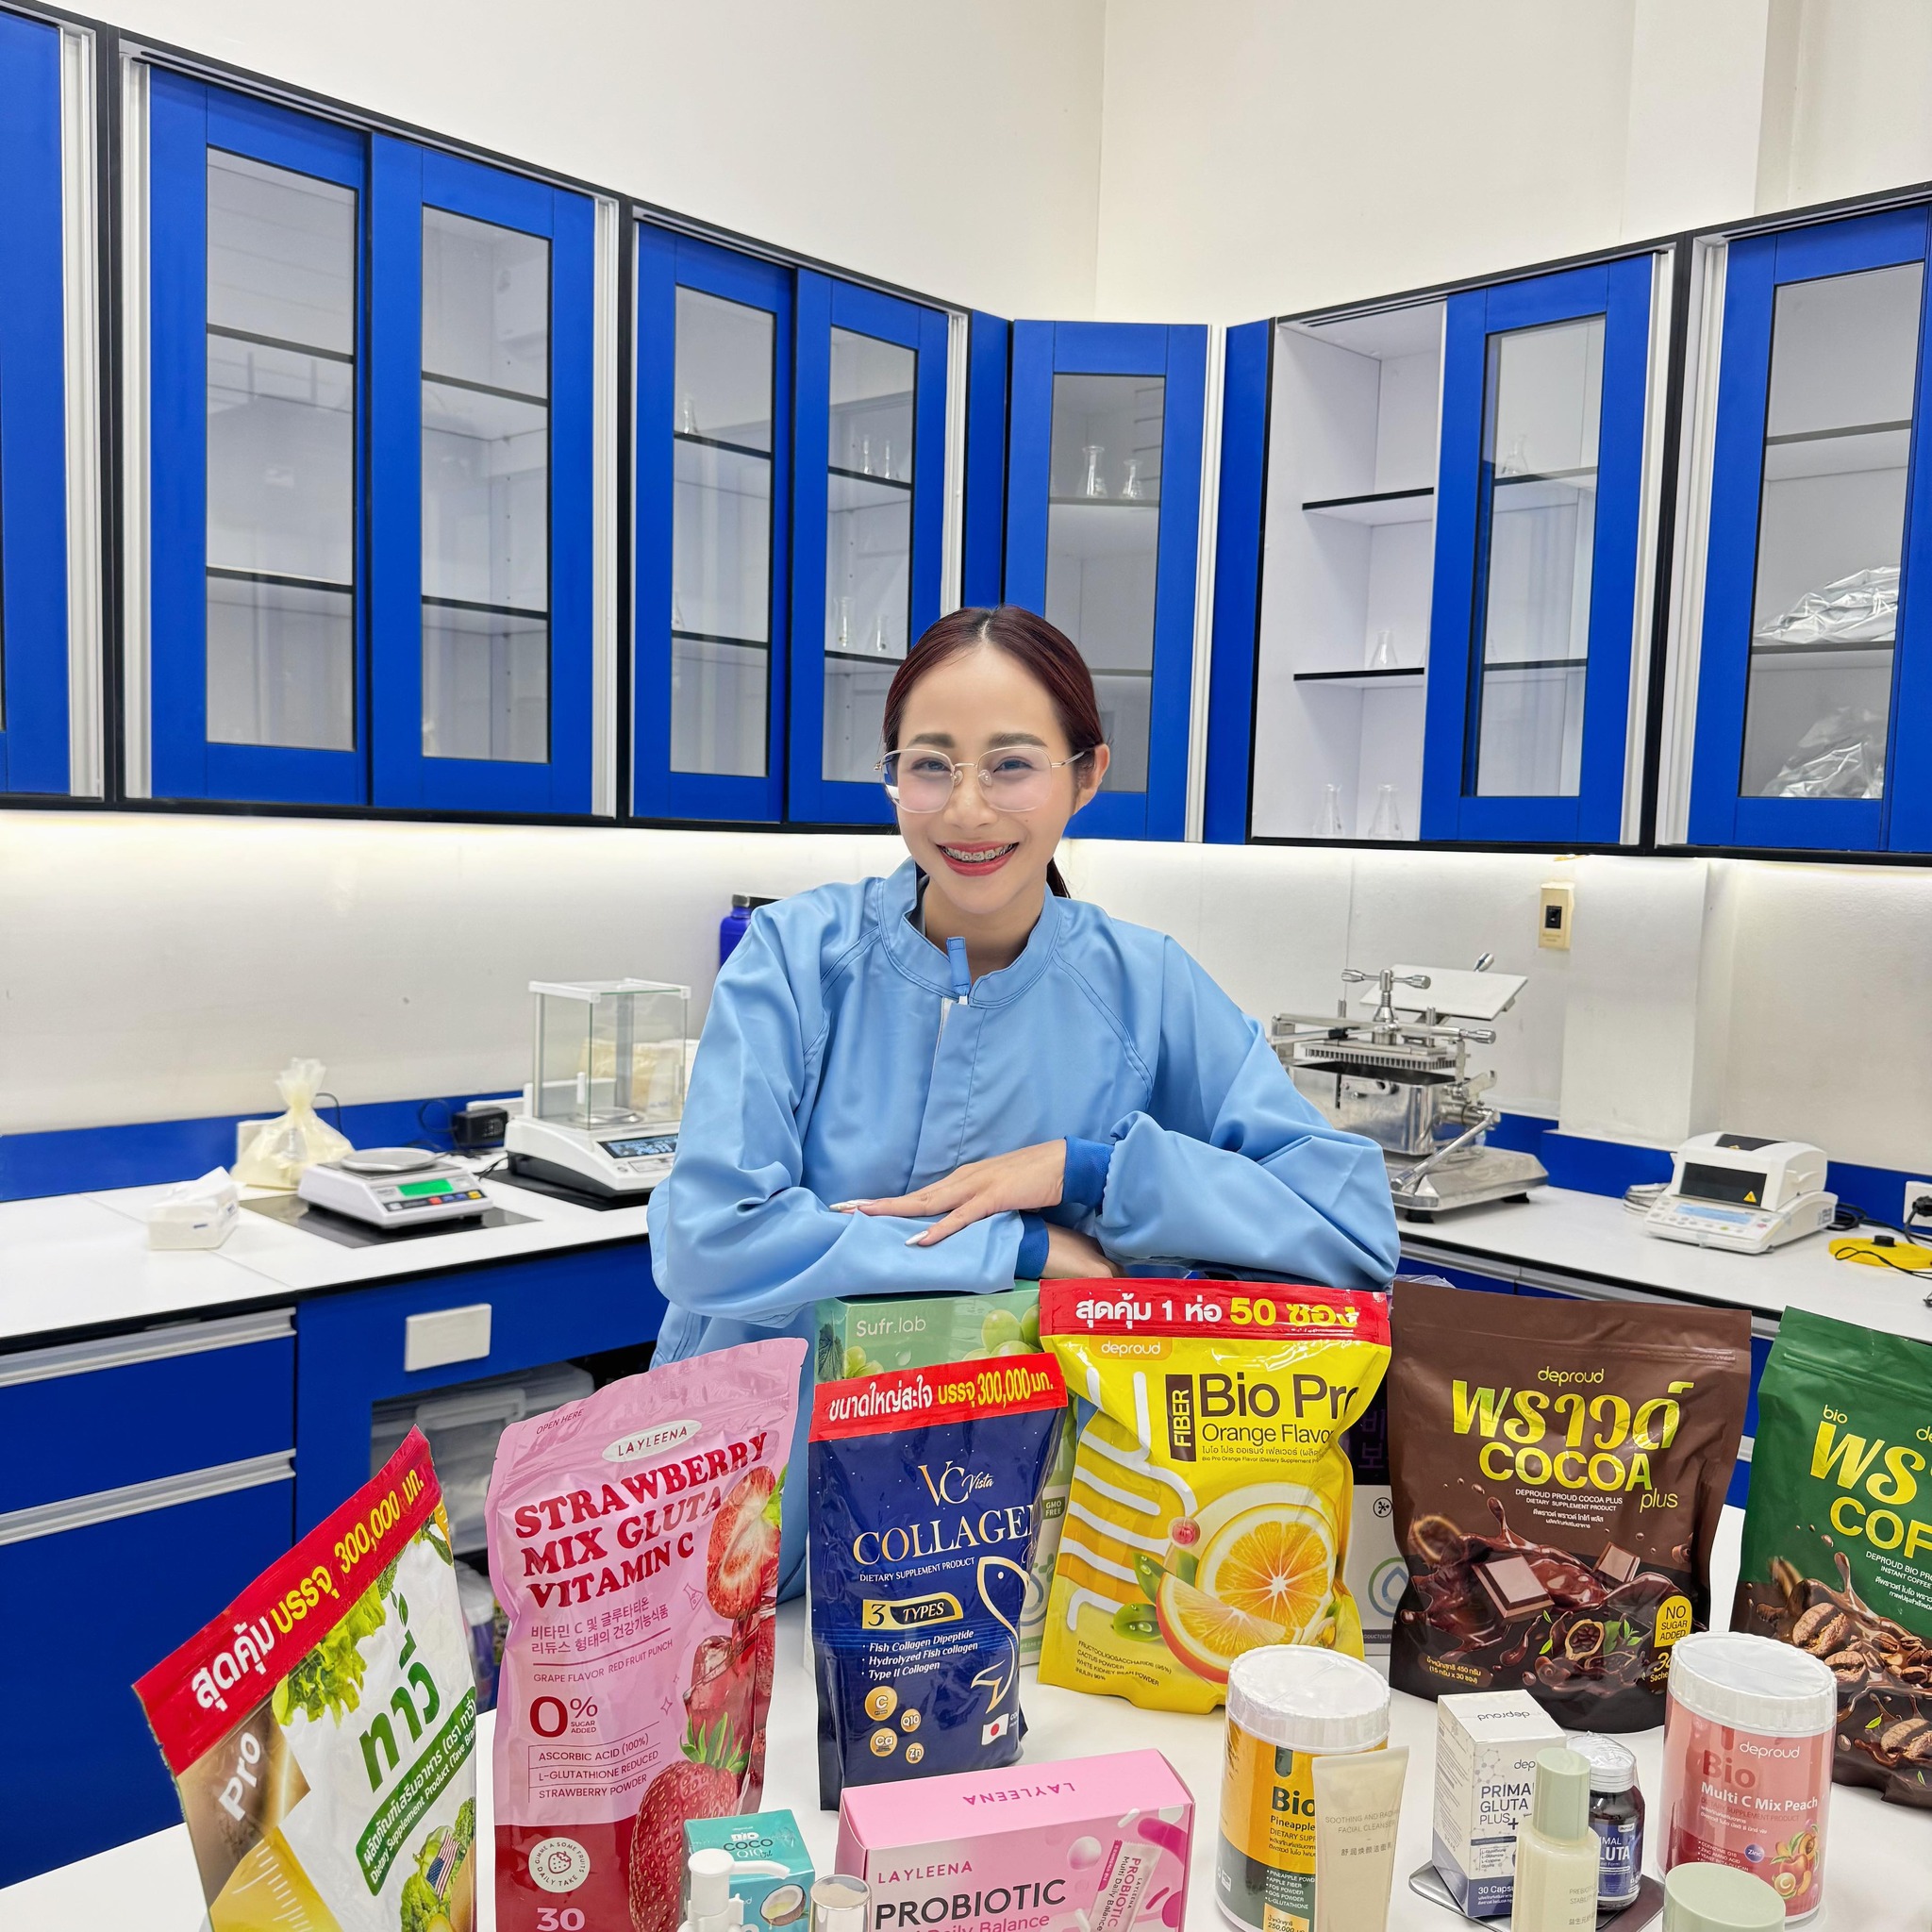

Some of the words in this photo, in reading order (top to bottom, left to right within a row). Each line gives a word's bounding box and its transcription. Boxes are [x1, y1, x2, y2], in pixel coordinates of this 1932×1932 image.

[1075, 1292, 1152, 1329] สุดคุ้ม
[1161, 1300, 1173, 1322] 1
[1185, 1295, 1222, 1322] ห่อ
[1230, 1298, 1276, 1326] 50
[856, 1315, 926, 1338] Sufr.lab
[1101, 1341, 1161, 1359] deproud
[1538, 1365, 1605, 1387] deproud
[829, 1374, 933, 1422] ขนาดใหญ่สะใจ
[938, 1379, 975, 1408] บรรจุ
[976, 1367, 1031, 1408] 300,000
[1031, 1371, 1055, 1393] มก.
[1199, 1372, 1280, 1418] Bio
[536, 1419, 559, 1436] OPEN
[561, 1408, 585, 1426] HERE
[1172, 1388, 1191, 1448] FIBER
[1452, 1379, 1695, 1451] พราวด์
[1823, 1404, 1848, 1424] bio
[618, 1426, 689, 1457] LAYLEENA
[1202, 1423, 1276, 1446] Orange
[1281, 1424, 1334, 1443] Flavo
[1478, 1441, 1653, 1492] COCOA
[514, 1432, 769, 1539] STRAWBERRY
[962, 1471, 994, 1494] Vista
[1045, 1500, 1062, 1509] GMO
[1515, 1489, 1551, 1499] DEPROUD
[1552, 1492, 1577, 1502] PROUD
[1579, 1494, 1605, 1504] COCOA
[1552, 1500, 1590, 1509] SUPPLEMENT
[1640, 1488, 1678, 1513] plus
[1045, 1507, 1062, 1517] FREE
[522, 1526, 608, 1577] MIX
[616, 1486, 723, 1550] GLUTA
[1830, 1496, 1932, 1559] COF
[526, 1541, 671, 1609] VITAMIN
[676, 1532, 695, 1558] C
[859, 1573, 894, 1582] DIETARY
[896, 1564, 941, 1580] SUPPLEMENT
[942, 1557, 975, 1570] PRODUCT
[1865, 1551, 1904, 1570] DEPROUD
[1905, 1565, 1919, 1575] BIO
[1880, 1565, 1907, 1579] INSTANT
[1907, 1575, 1932, 1590] COFFEE
[192, 1617, 275, 1712] สุดคุ้ม
[270, 1565, 341, 1634] บรรจุ
[334, 1491, 401, 1574] 300,000
[402, 1469, 425, 1506] มก.
[531, 1624, 570, 1641] 비타민
[575, 1623, 583, 1634] C
[587, 1617, 598, 1633] 및
[600, 1596, 650, 1628] 글루타티온
[868, 1604, 886, 1627] 3
[903, 1602, 944, 1622] TYPES
[1661, 1620, 1689, 1630] SUGAR
[1666, 1605, 1687, 1621] NO
[531, 1641, 572, 1655] 리듀스
[575, 1629, 610, 1652] 형태의
[613, 1604, 669, 1641] 건강기능식품
[869, 1642, 890, 1653] Fish
[891, 1639, 931, 1653] Collagen
[933, 1629, 974, 1645] Dipeptide
[1659, 1629, 1687, 1641] ADDED
[533, 1674, 566, 1683] GRAPE
[568, 1668, 605, 1683] FLAVOR
[608, 1661, 625, 1674] RED
[625, 1651, 647, 1667] FRUIT
[648, 1639, 674, 1658] PUNCH
[868, 1651, 921, 1668] Hydrolyzed
[923, 1648, 941, 1659] Fish
[942, 1642, 978, 1657] collagen
[1076, 1649, 1098, 1663] CACTUS
[1098, 1658, 1124, 1670] POWDER
[868, 1669, 891, 1681] Type
[902, 1661, 941, 1675] Collagen
[1134, 1671, 1159, 1687] POWDER
[875, 1694, 889, 1709] C
[903, 1714, 921, 1728] Q10
[1477, 1710, 1530, 1722] deproud
[539, 1751, 592, 1761] ASCORBIC
[595, 1748, 621, 1761] ACID
[622, 1733, 649, 1757] (100%)
[874, 1735, 894, 1746] Ca
[908, 1747, 923, 1758] Zn
[1740, 1740, 1800, 1759] deproud
[218, 1732, 261, 1822] Pro
[539, 1766, 620, 1782] L-GLUTATHIONE
[621, 1749, 658, 1774] REDUCED
[1702, 1749, 1757, 1789] Bio
[539, 1788, 608, 1799] STRAWBERRY
[609, 1774, 648, 1796] POWDER
[962, 1781, 1075, 1807] LAYLEENA
[1481, 1782, 1535, 1799] PRIMA
[1701, 1781, 1738, 1805] Multi
[1741, 1795, 1752, 1807] C
[1755, 1797, 1781, 1811] Mix
[1785, 1796, 1818, 1811] Peach
[1272, 1786, 1315, 1817] Bio
[1480, 1799, 1529, 1813] GLUTA
[370, 1842, 391, 1885] Dietary
[388, 1796, 425, 1852] Supplement
[425, 1764, 450, 1800] Product
[1270, 1815, 1315, 1832] Pineapple
[1324, 1814, 1363, 1824] SOOTHING
[723, 1839, 774, 1851] COCO
[1270, 1827, 1299, 1840] DIETARY
[535, 1844, 548, 1864] GIMME
[557, 1841, 577, 1852] SOME
[576, 1848, 586, 1874] FRUITS
[1747, 1849, 1762, 1857] Zinc
[537, 1866, 557, 1886] DAILY
[558, 1874, 578, 1887] TAKE
[878, 1860, 973, 1884] LAYLEENA
[1118, 1856, 1130, 1877] Multi
[1270, 1870, 1298, 1882] PINEAPPLE
[1108, 1877, 1123, 1898] Daily
[1108, 1857, 1141, 1927] PROBIOTIC
[1127, 1877, 1142, 1909] LAYLEENA
[1269, 1877, 1286, 1886] APPLE
[1280, 1887, 1304, 1895] POWDER
[1477, 1887, 1489, 1895] 30
[1491, 1885, 1513, 1893] Caps
[1779, 1877, 1791, 1889] C
[874, 1878, 1067, 1930] PROBIOTIC
[1280, 1893, 1305, 1902] POWDER
[536, 1907, 586, 1932] 30
[1096, 1899, 1114, 1932] Balance
